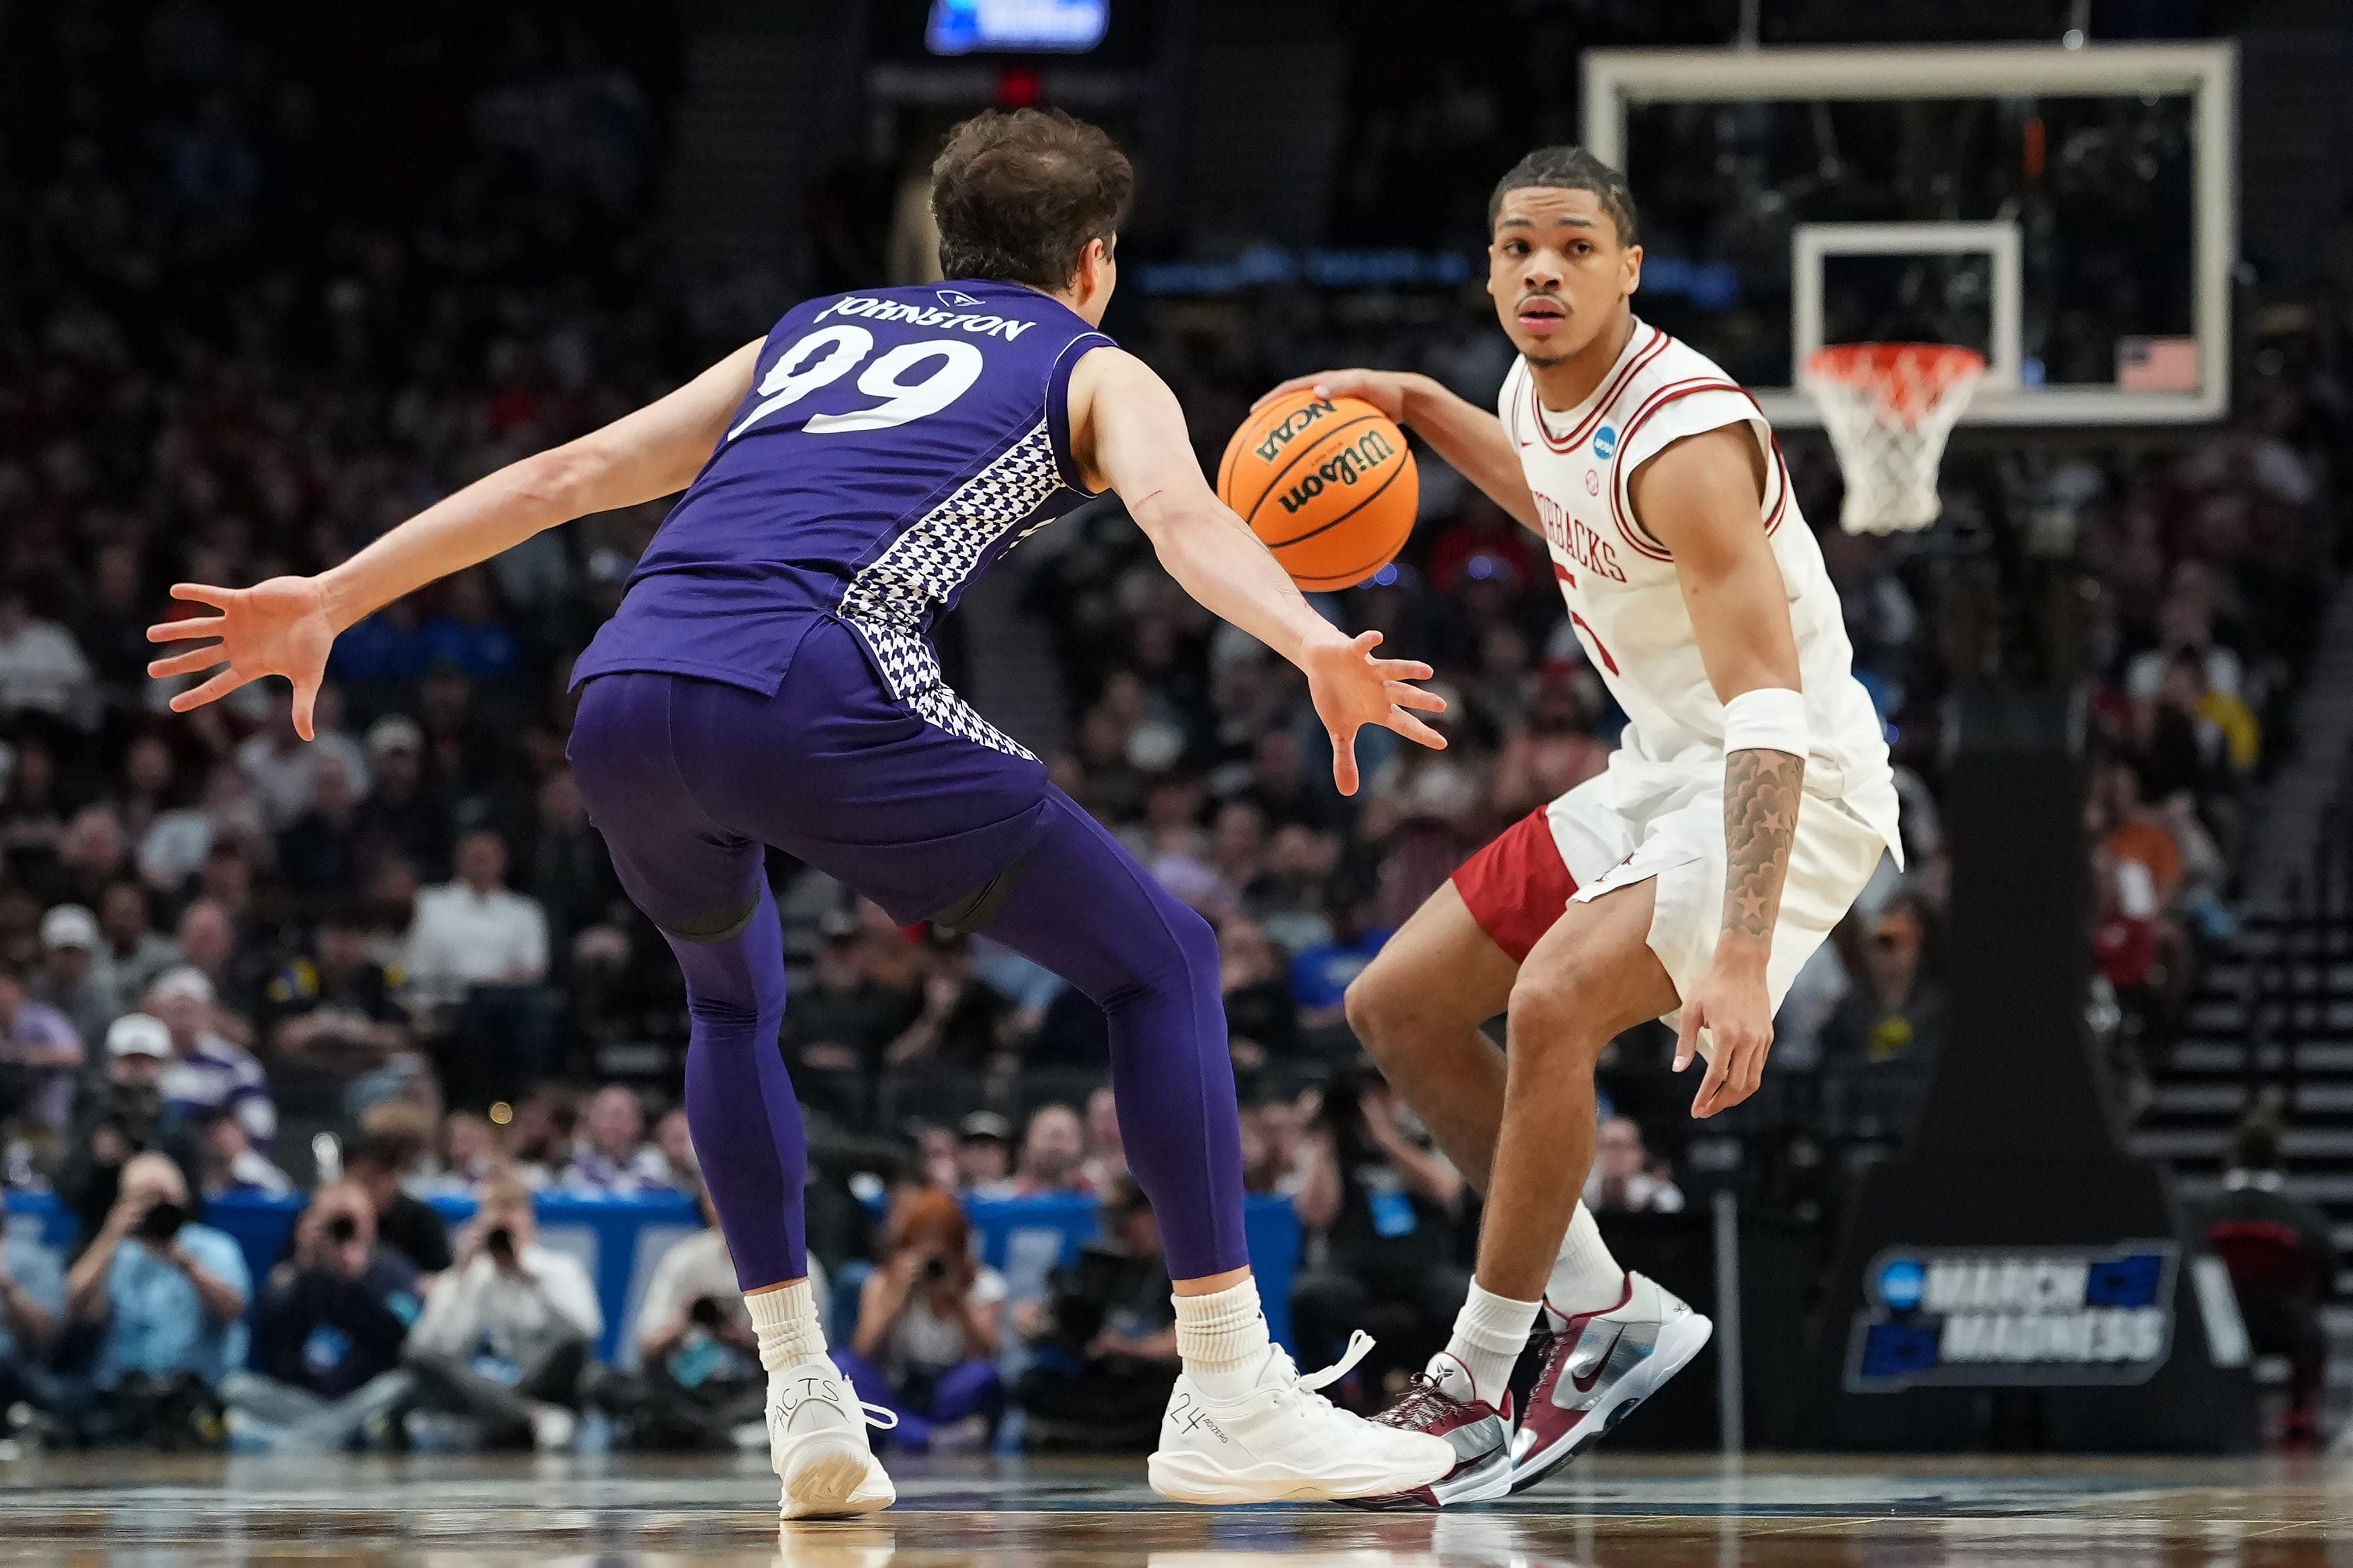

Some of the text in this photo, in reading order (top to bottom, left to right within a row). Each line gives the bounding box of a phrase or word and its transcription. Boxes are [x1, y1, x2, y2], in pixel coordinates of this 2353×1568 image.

[813, 295, 1037, 343] JOHNSTON
[727, 324, 983, 442] 99
[1256, 399, 1337, 462] NCAA
[1278, 429, 1395, 514] Wilson
[775, 1378, 840, 1429] ACTS
[1170, 1392, 1206, 1435] 24
[1202, 1418, 1229, 1444] ADIZERO
